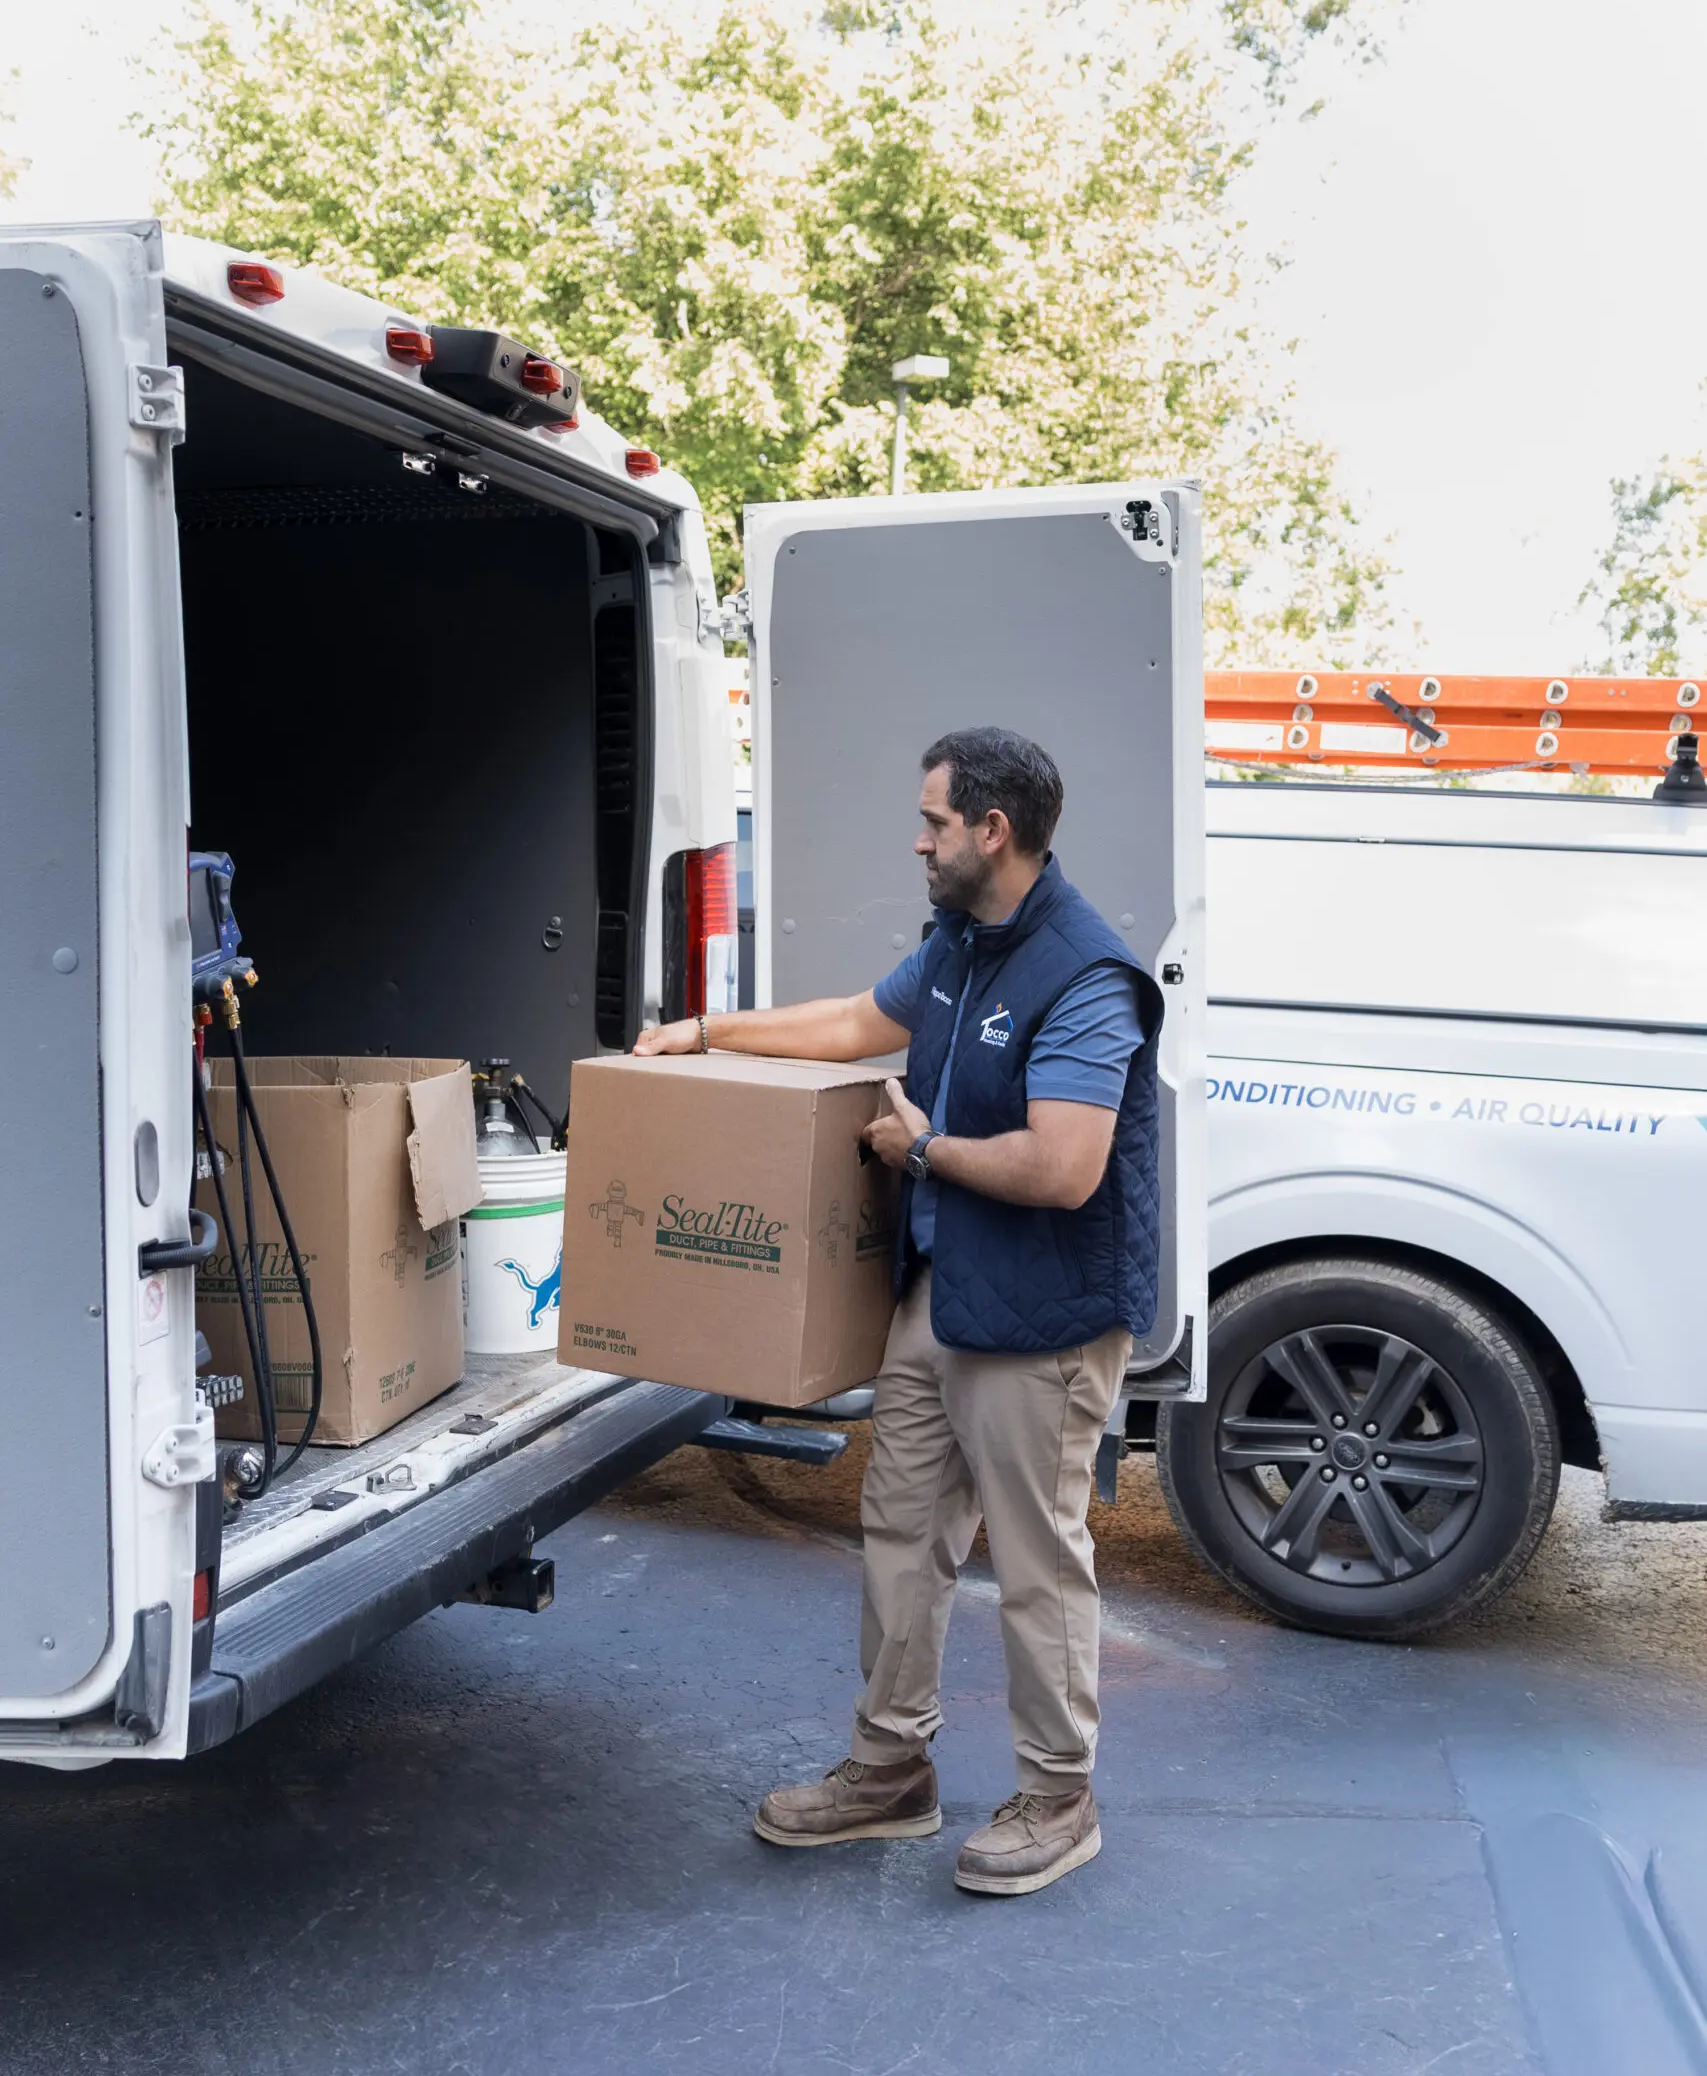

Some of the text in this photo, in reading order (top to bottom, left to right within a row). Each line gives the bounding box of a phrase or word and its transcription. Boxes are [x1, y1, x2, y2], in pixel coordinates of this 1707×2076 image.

[1451, 1098, 1508, 1123] AIR
[1518, 1102, 1669, 1135] QUALITY
[669, 1234, 771, 1258] DUCT, PIPE & FITTINGS
[684, 1252, 703, 1263] MADE
[704, 1255, 712, 1264] IN
[766, 1265, 780, 1274] USA
[261, 1280, 300, 1290] ITTINGS
[573, 1336, 607, 1351] ELBOWS
[606, 1328, 626, 1341] 30GA
